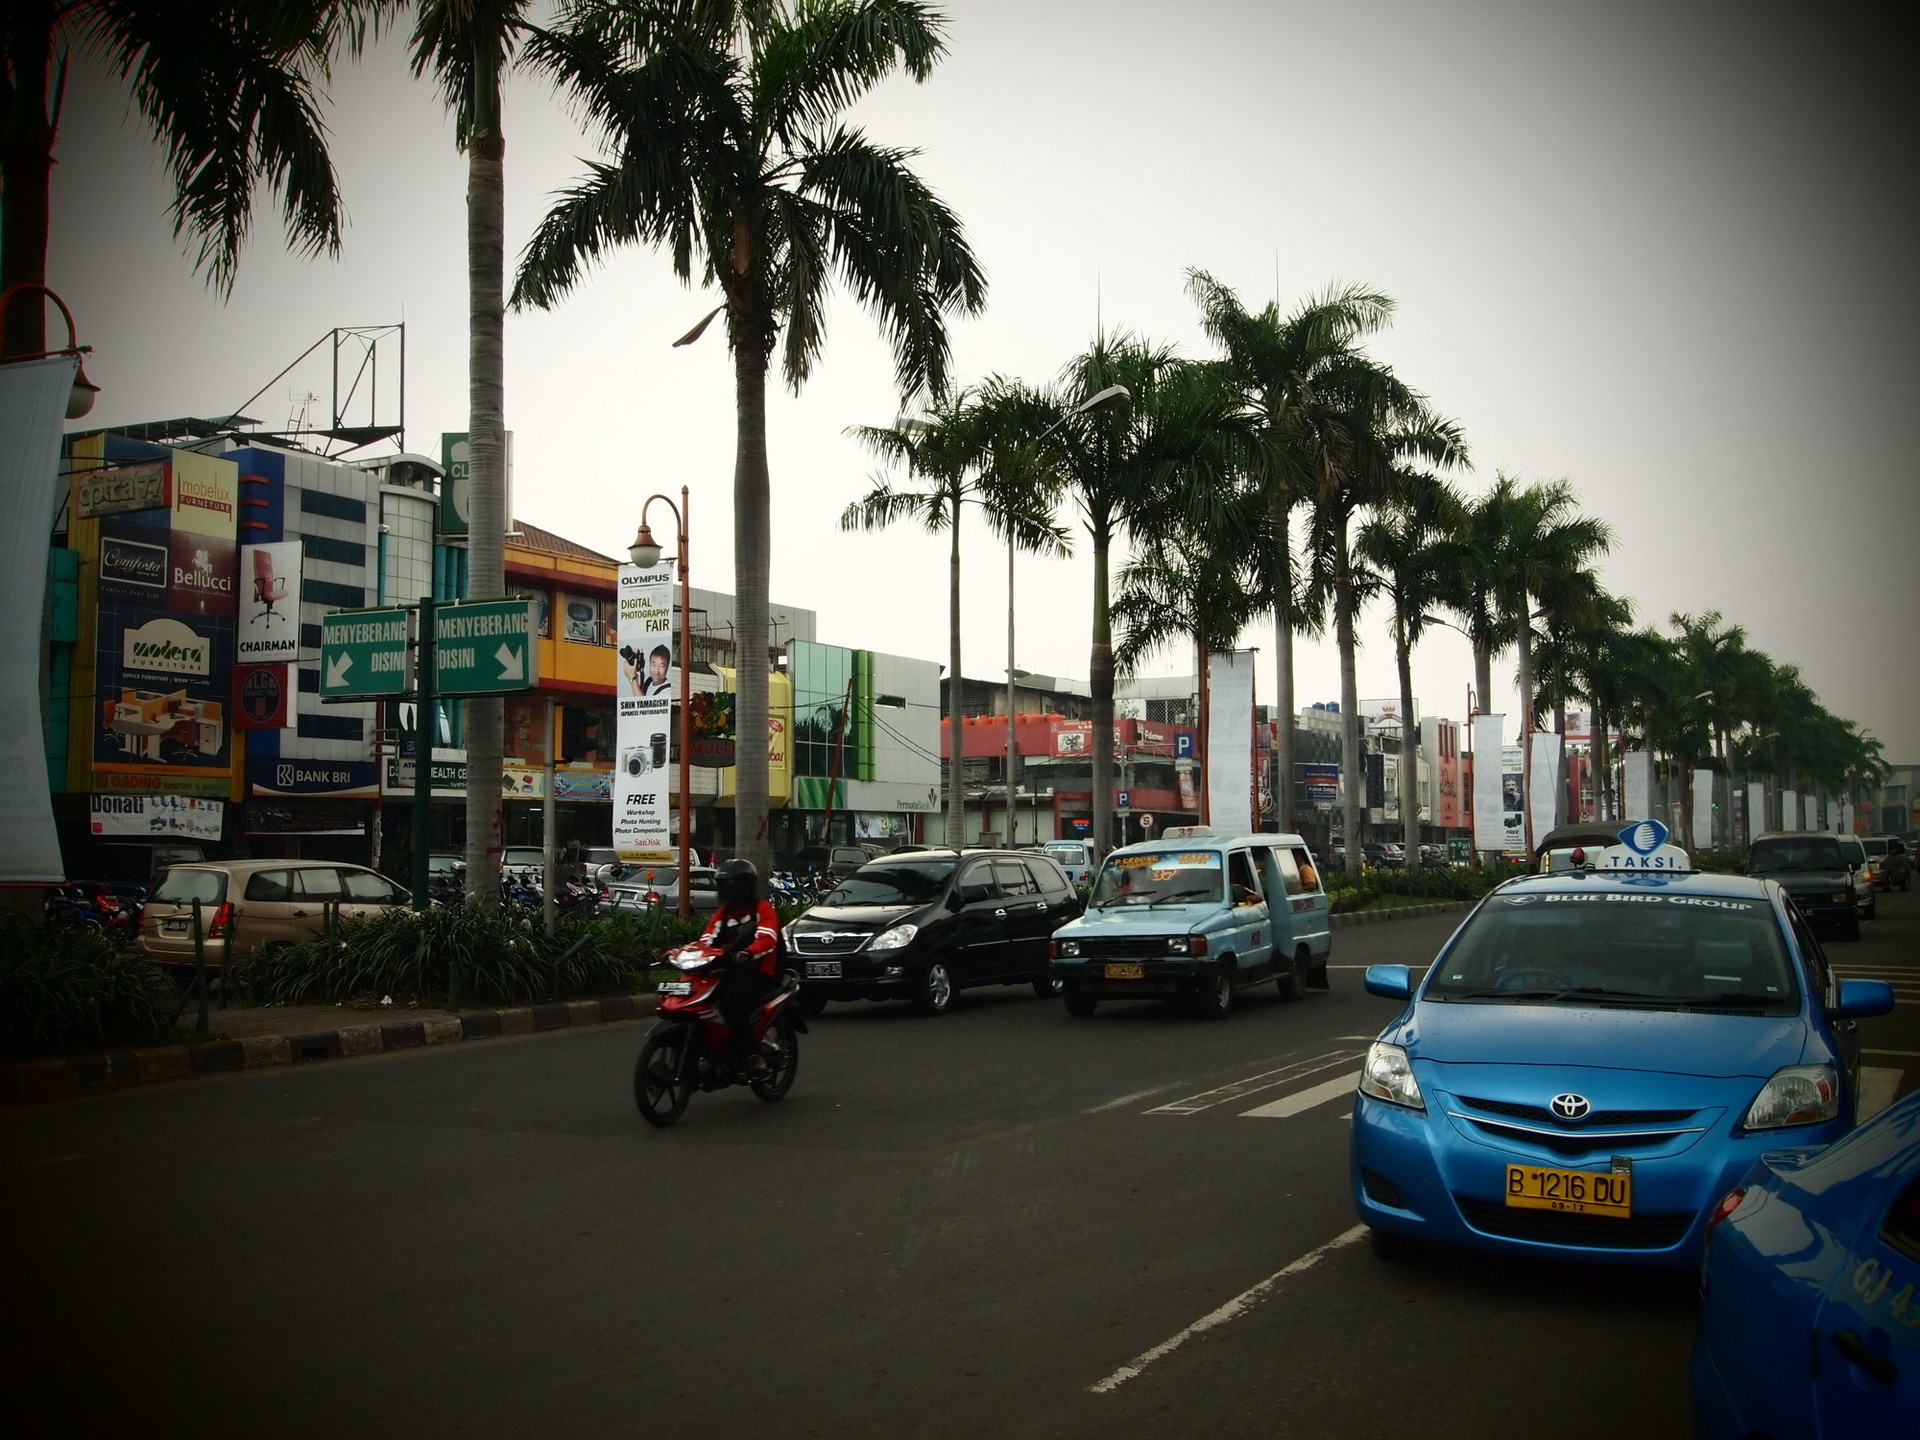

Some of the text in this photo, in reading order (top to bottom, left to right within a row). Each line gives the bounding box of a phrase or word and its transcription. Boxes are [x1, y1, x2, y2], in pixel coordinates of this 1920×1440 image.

[182, 472, 230, 501] mobelux
[180, 496, 231, 512] FURNITURE
[104, 549, 160, 573] Comforta
[174, 567, 231, 592] Bellucci
[621, 573, 669, 585] OLYMPUS
[621, 598, 652, 609] DIGITAL
[621, 608, 670, 619] PHOTOGRAPHY
[439, 612, 528, 639] MENYEBERANG
[645, 618, 670, 632] FAIR
[323, 621, 406, 645] MENYEBERANG
[133, 641, 202, 662] modera
[240, 639, 295, 652] CHAIRMAN
[132, 659, 202, 671] FURNITURE
[371, 651, 405, 672] DISINI
[439, 648, 475, 670] DISINI
[621, 699, 669, 710] SHIN YAMAGISHI
[1178, 736, 1189, 754] P
[111, 775, 162, 789] GADING
[296, 770, 350, 783] BANK BRI
[91, 795, 144, 813] Donati
[626, 794, 656, 805] FREE
[1178, 828, 1193, 837] 37
[1611, 856, 1673, 868] TAKSI
[1152, 870, 1177, 881] 37
[1544, 894, 1752, 910] BLUE BIRD GROUP
[1509, 1168, 1625, 1204] B 1216 DU
